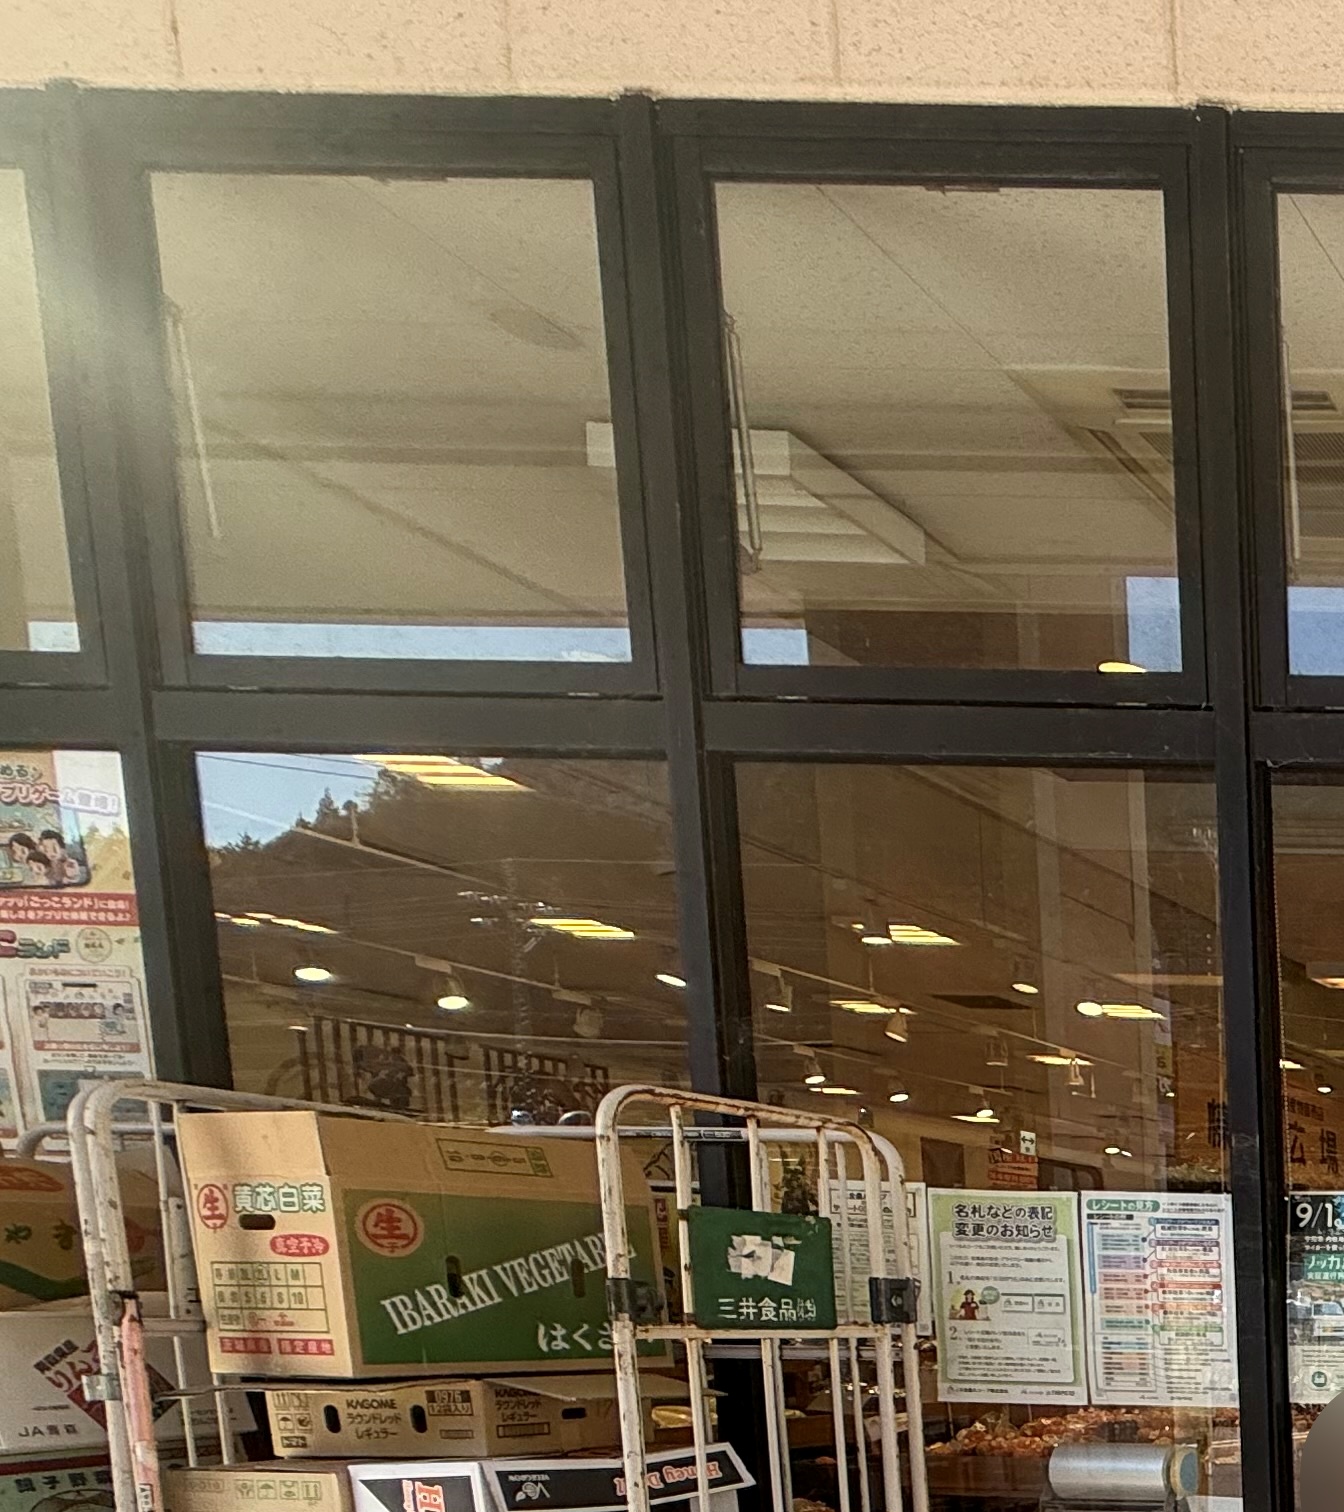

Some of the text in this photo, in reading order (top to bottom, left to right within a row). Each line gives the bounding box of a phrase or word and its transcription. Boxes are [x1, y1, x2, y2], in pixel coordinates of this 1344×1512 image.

[954, 1203, 1054, 1220] 名札などの表記
[954, 1222, 1054, 1239] 変更のお知らせ
[380, 1266, 503, 1335] IBARAKI
[346, 1398, 398, 1410] KAGOME
[355, 1427, 399, 1440] レギュラー
